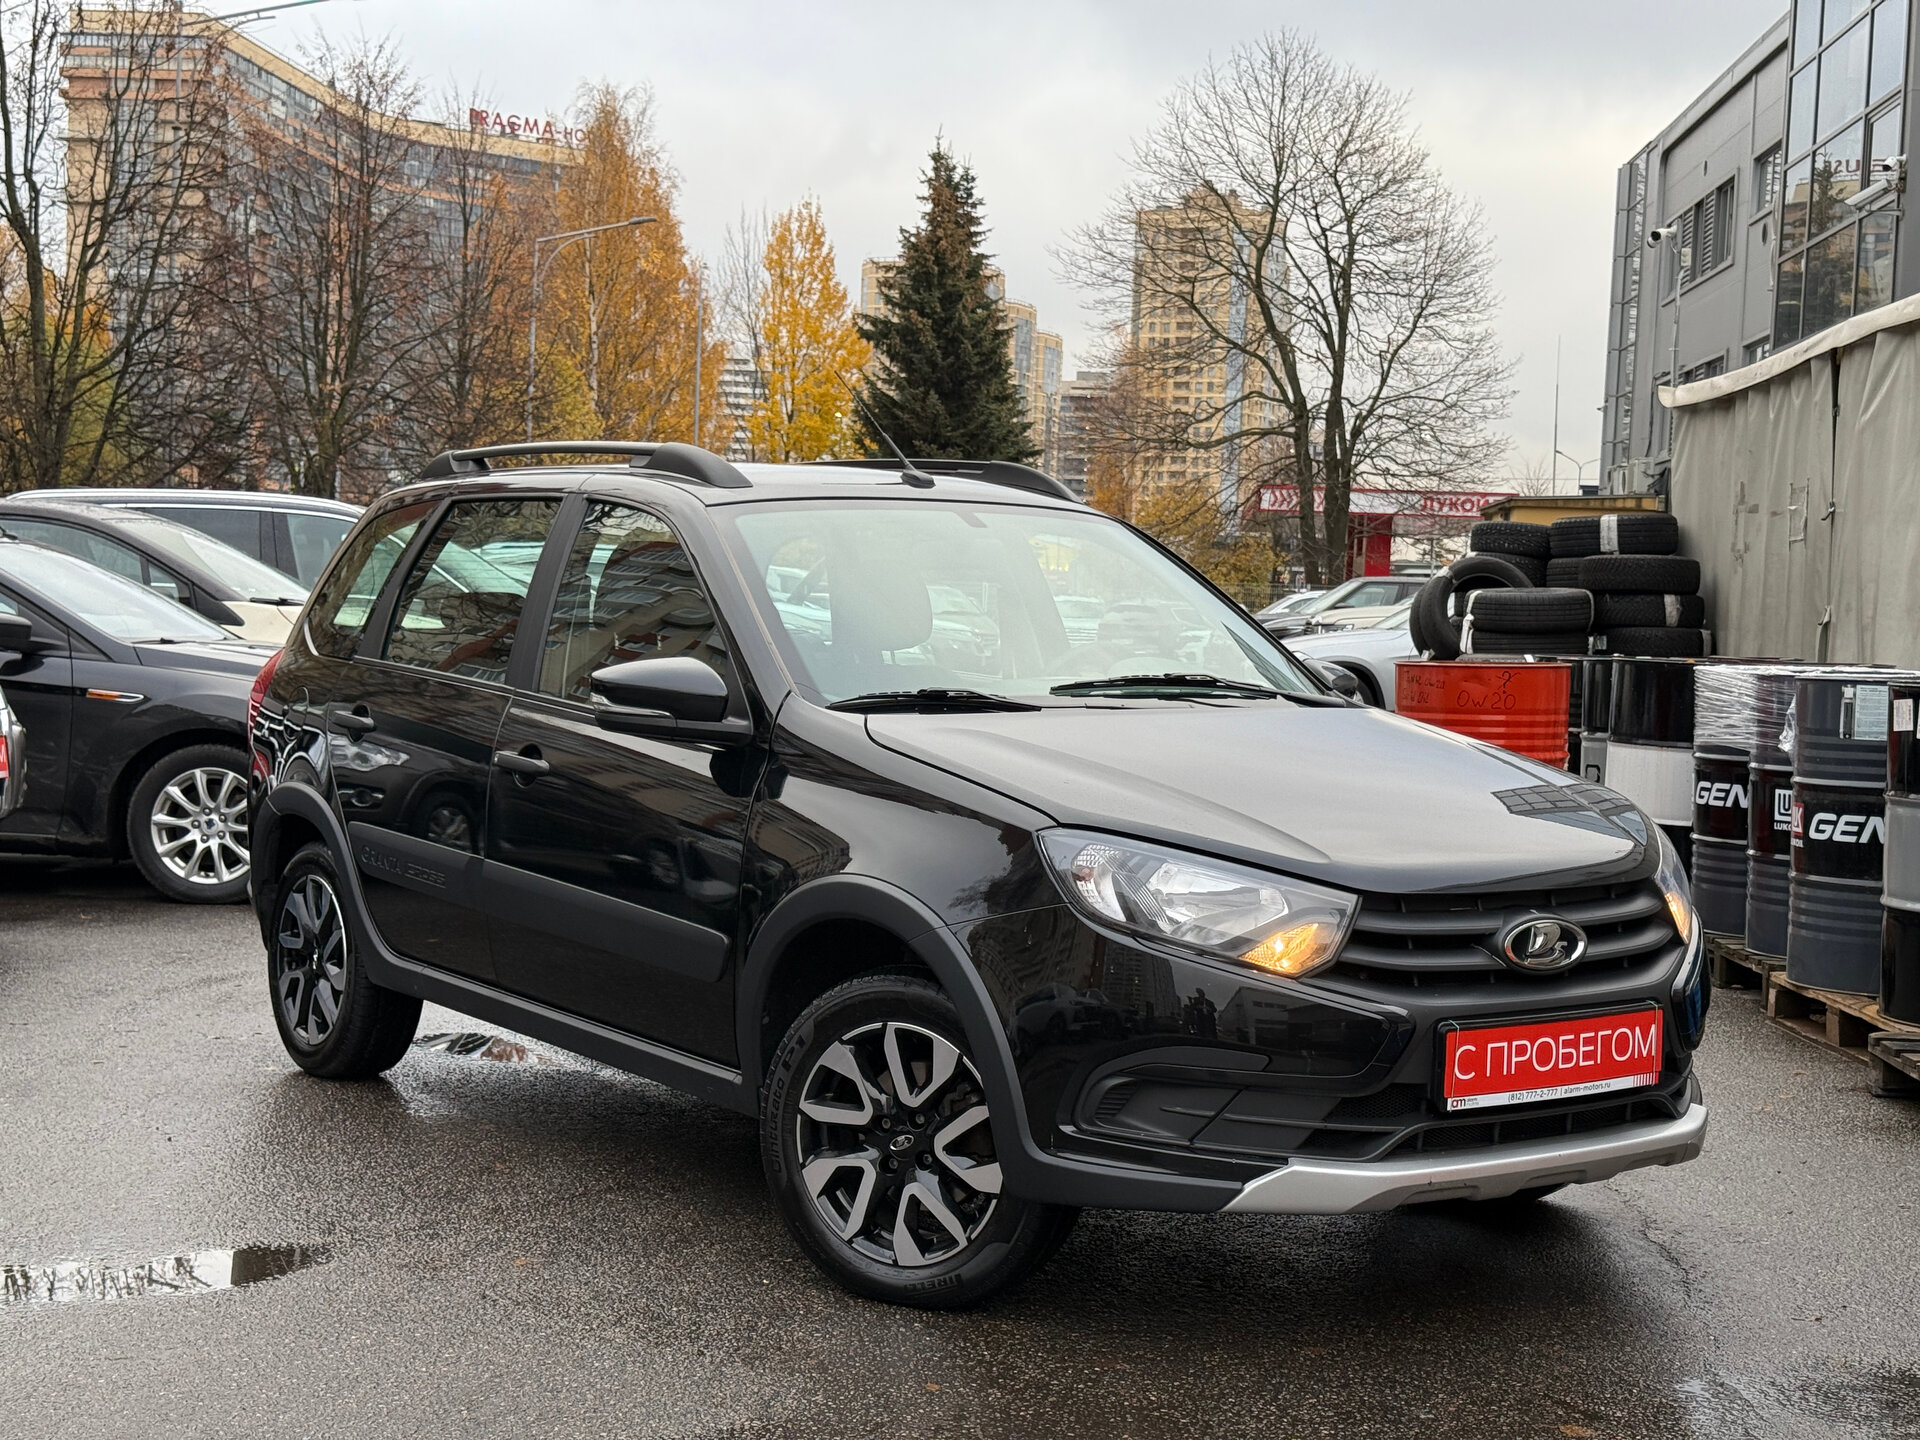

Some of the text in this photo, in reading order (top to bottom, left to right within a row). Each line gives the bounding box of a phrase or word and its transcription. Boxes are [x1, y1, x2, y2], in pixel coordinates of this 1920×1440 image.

[1455, 1024, 1657, 1080] С ПРОБЕГОМ
[1508, 1081, 1611, 1103] (812) 777-2-777 alarm-motors.ru
